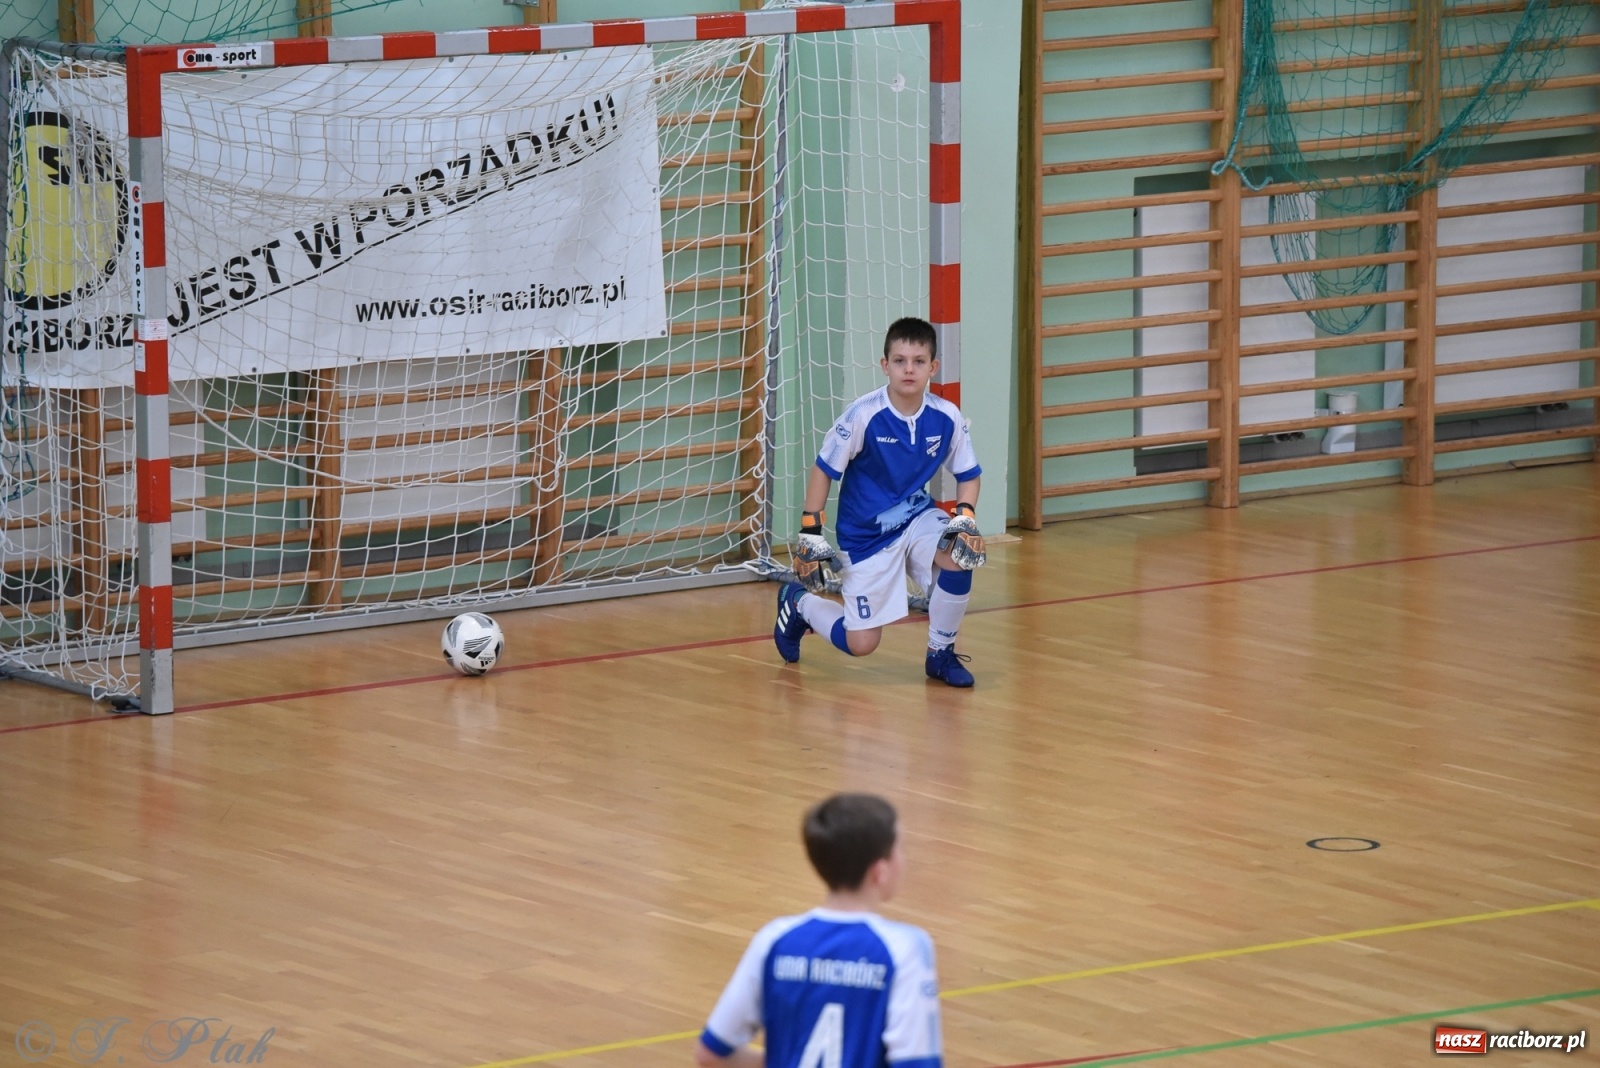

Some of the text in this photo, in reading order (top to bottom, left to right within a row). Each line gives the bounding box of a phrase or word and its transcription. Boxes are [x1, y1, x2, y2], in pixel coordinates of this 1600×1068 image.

[222, 49, 257, 64] sport
[167, 239, 282, 328] JEST
[294, 216, 342, 270] W
[355, 275, 628, 323] www.osir-raciborz.pl
[856, 595, 871, 620] 6
[797, 1002, 846, 1068] 4
